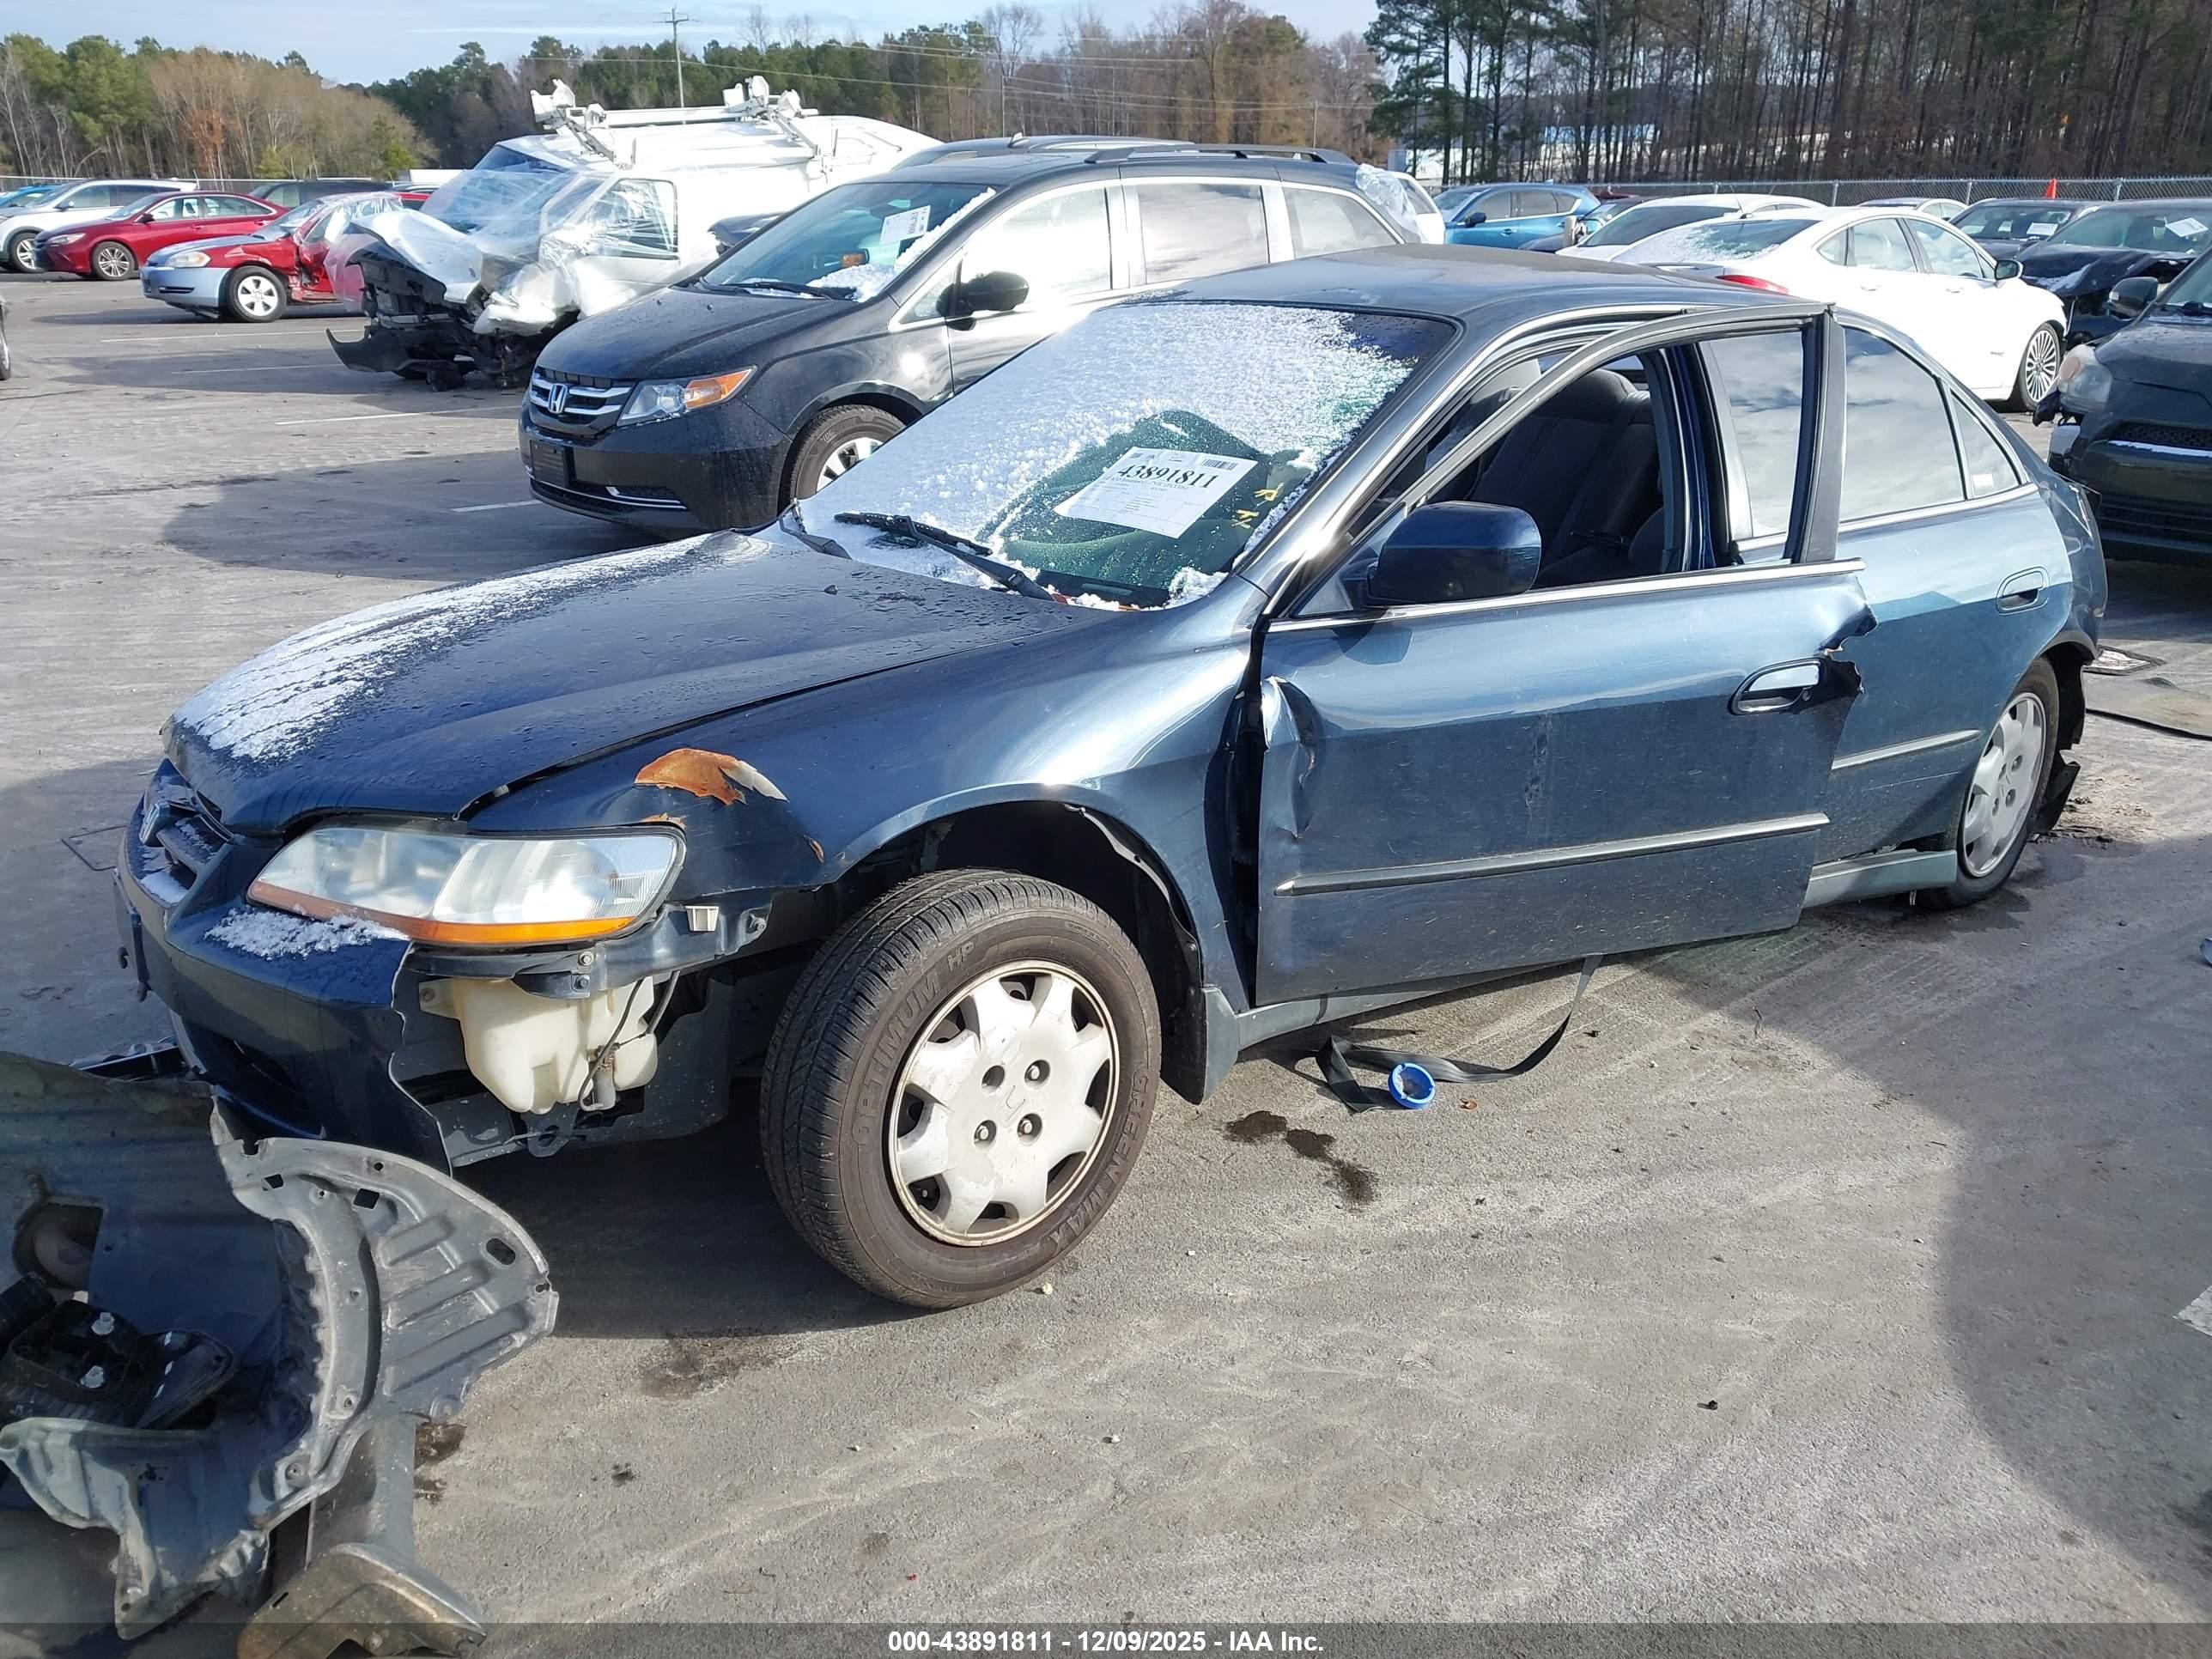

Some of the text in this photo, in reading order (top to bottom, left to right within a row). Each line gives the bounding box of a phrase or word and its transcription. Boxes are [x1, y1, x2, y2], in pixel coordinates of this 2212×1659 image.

[1118, 464, 1219, 488] 43891811
[852, 939, 975, 1146] OPTIMUM HP
